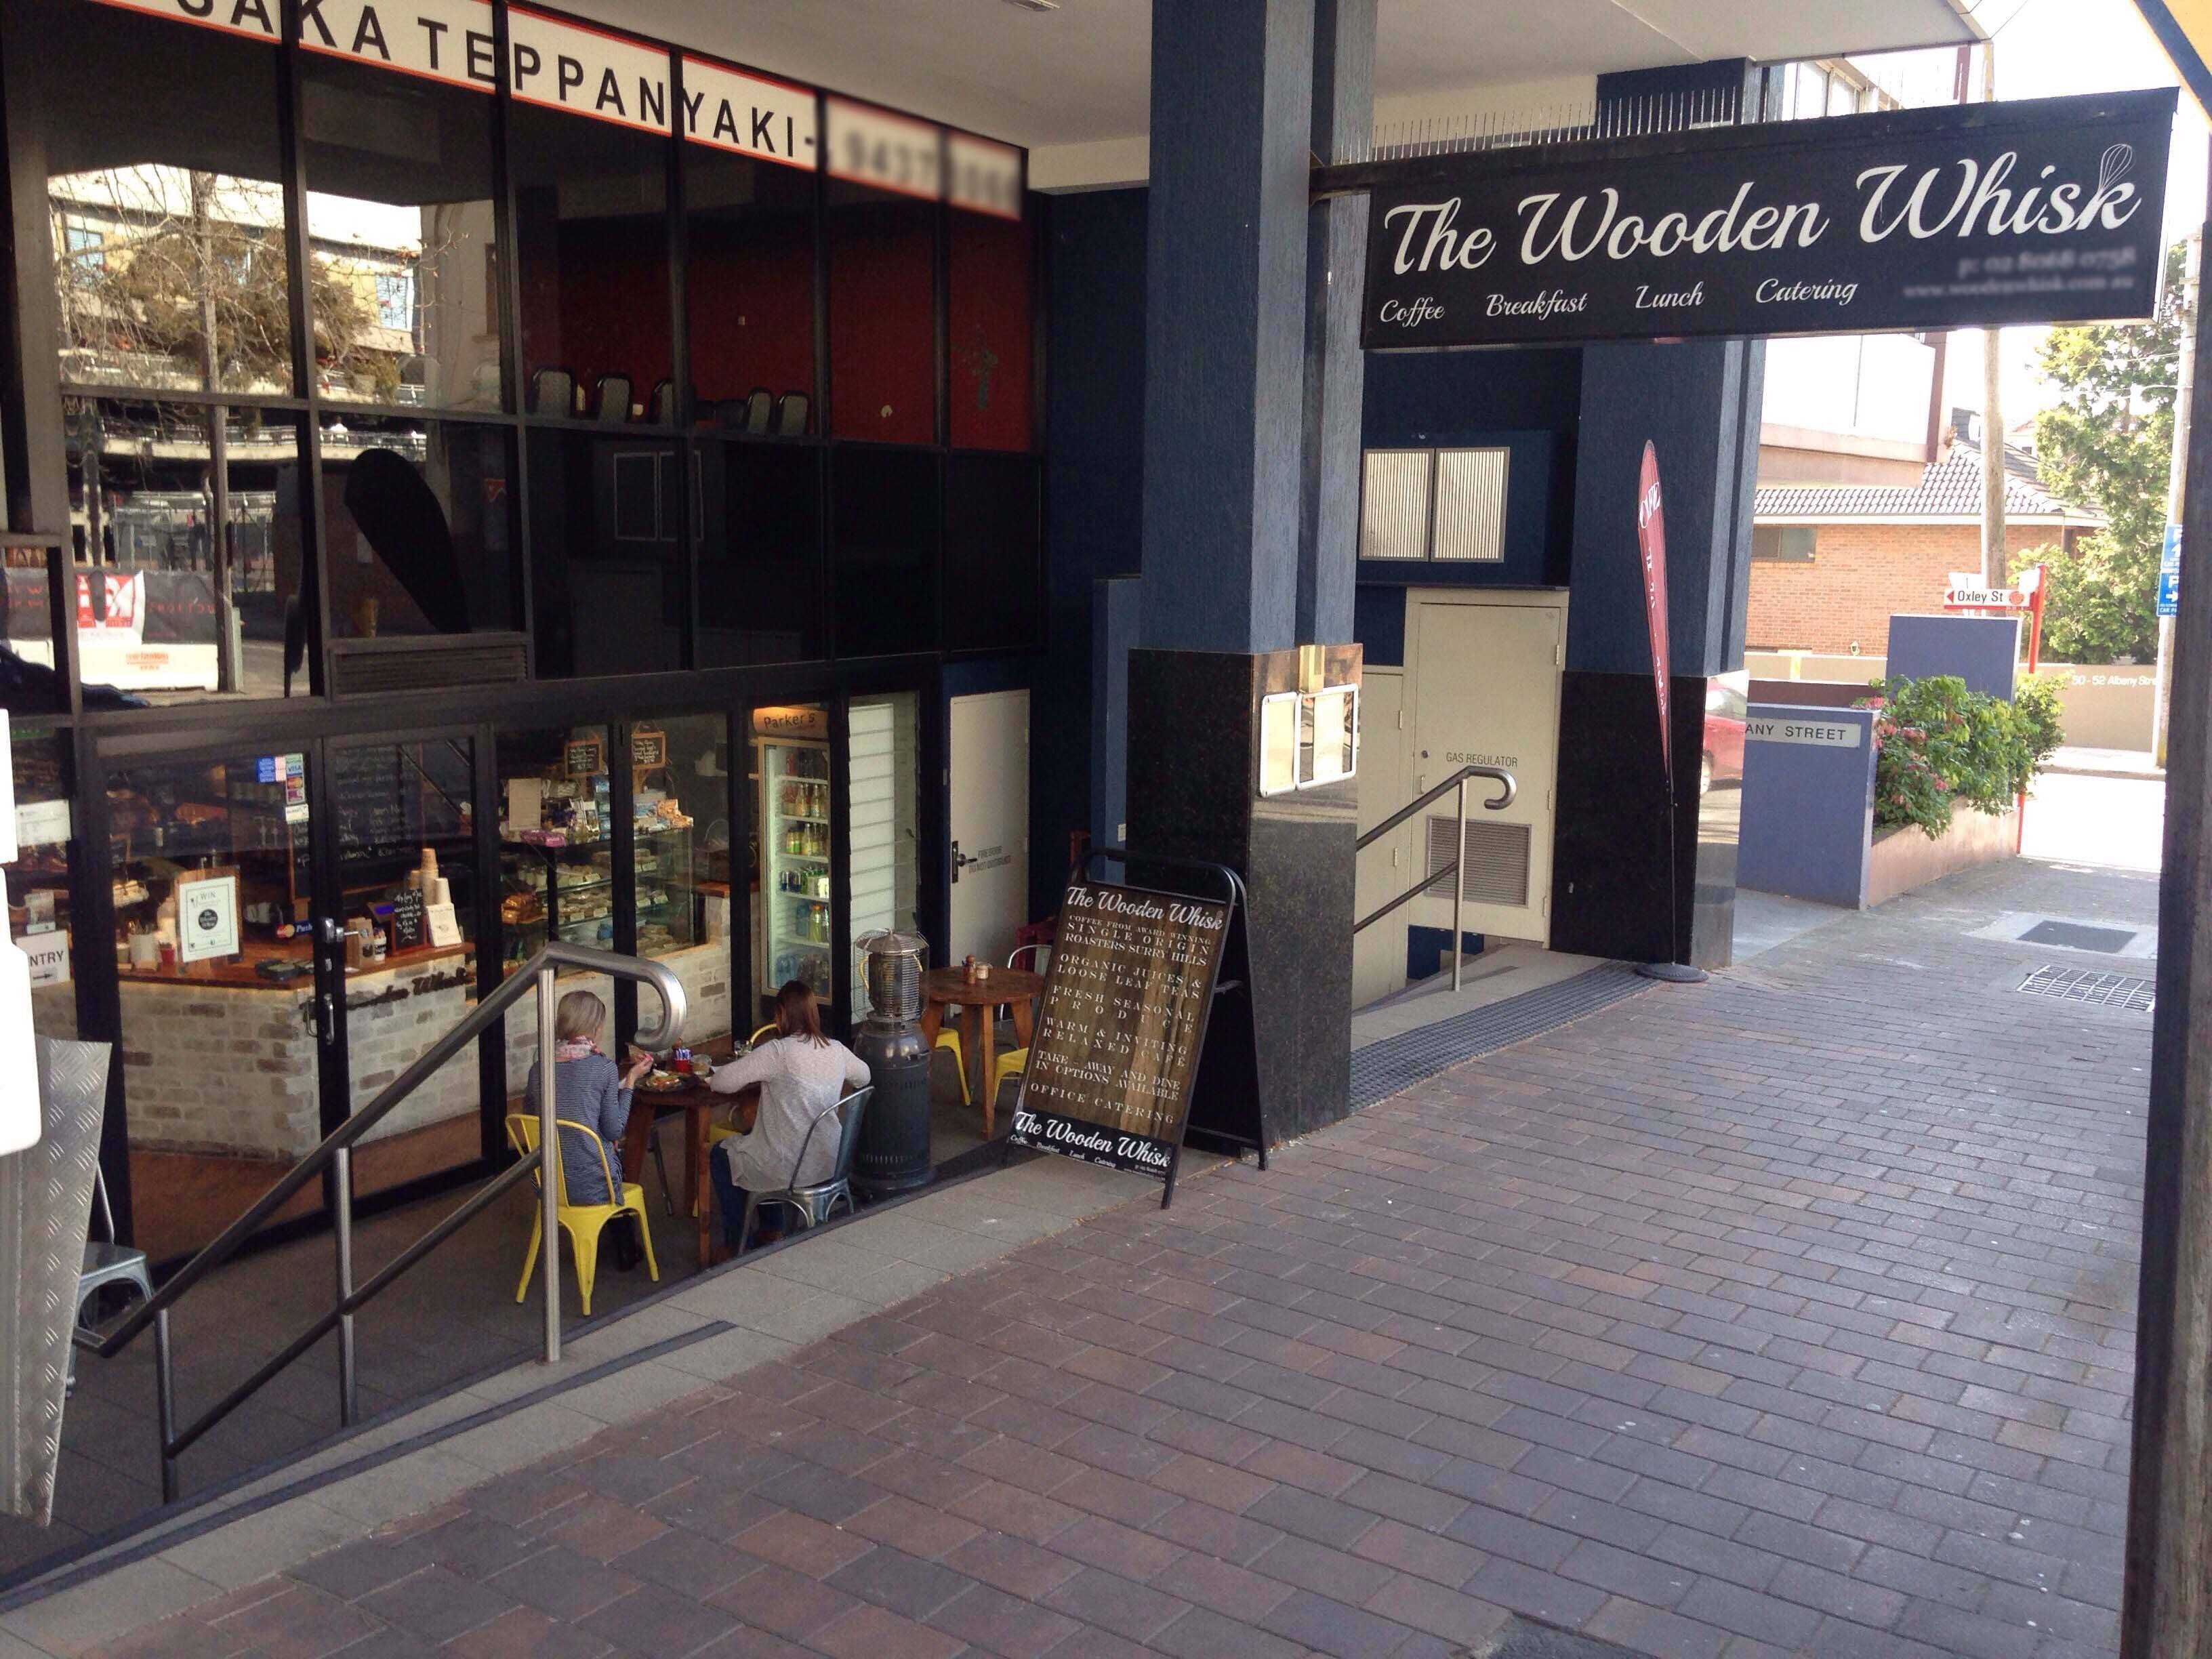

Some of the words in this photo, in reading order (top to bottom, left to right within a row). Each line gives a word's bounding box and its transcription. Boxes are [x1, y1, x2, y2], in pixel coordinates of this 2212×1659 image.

[1385, 197, 1497, 275] The
[1517, 182, 1830, 265] Wooden
[1856, 144, 2142, 243] Whisk
[1380, 297, 1446, 327] Coffee
[1486, 289, 1589, 321] Breakfast
[1635, 281, 1705, 309] Lunch
[1755, 278, 1858, 306] Catering
[1958, 590, 1987, 603] Oxley
[1991, 591, 2003, 602] St
[2092, 675, 2106, 685] 52
[2107, 675, 2137, 687] Albany
[1785, 726, 1846, 740] STREET
[1446, 752, 1464, 763] GAS
[1466, 753, 1518, 767] REGULATOR
[200, 892, 216, 900] WIN
[1067, 886, 1094, 907] The
[1098, 892, 1164, 920] Wooden
[1169, 903, 1223, 930] Whisk
[1067, 922, 1132, 941] SINGLE
[1143, 935, 1209, 955] ORIGIN
[1069, 915, 1103, 926] COFFEE
[1107, 921, 1131, 931] FROM
[1136, 927, 1165, 937] AWARD
[1170, 933, 1211, 945] WINNING
[1065, 933, 1126, 951] ROASTERS
[1128, 943, 1167, 959] SURRY
[1171, 952, 1207, 966] HILLS
[1057, 964, 1107, 982] LOOSE
[1116, 975, 1152, 990] LEAF
[1161, 984, 1200, 1000] TEAS
[1060, 954, 1126, 974] ORGANIC
[1133, 967, 1184, 983] JUICES
[1191, 979, 1202, 989] &
[1050, 996, 1193, 1033] PRODUCE
[1053, 985, 1104, 1003] FRESH
[1113, 997, 1195, 1022] SEASONAL
[1043, 1028, 1130, 1054] RELAXED
[1046, 1017, 1088, 1033] WARM
[1097, 1029, 1106, 1038] &
[1116, 1031, 1187, 1055] INVITING
[1036, 1060, 1049, 1071] IN
[1056, 1065, 1109, 1084] OPTIONS
[1115, 1080, 1179, 1101] AVAILABLE
[1038, 1050, 1069, 1065] TAKE
[1084, 1061, 1115, 1075] AWAY
[1121, 1070, 1147, 1082] AND
[1152, 1076, 1181, 1091] DINE
[1030, 1082, 1085, 1103] OFFICE
[1094, 1098, 1174, 1124] CATERING
[1016, 1111, 1042, 1135] The
[1046, 1119, 1113, 1153] Wooden
[1118, 1136, 1171, 1168] Whisk
